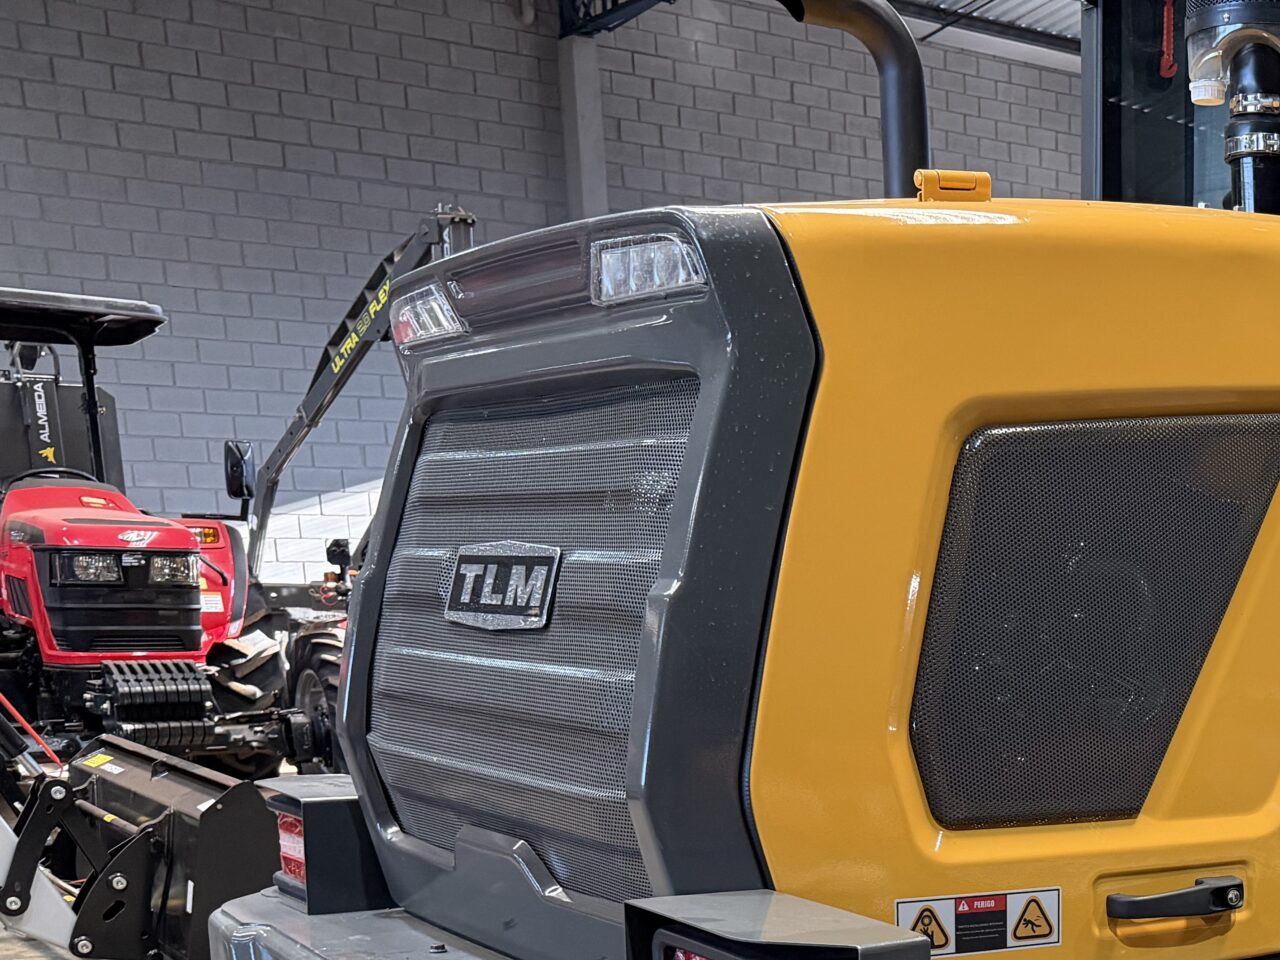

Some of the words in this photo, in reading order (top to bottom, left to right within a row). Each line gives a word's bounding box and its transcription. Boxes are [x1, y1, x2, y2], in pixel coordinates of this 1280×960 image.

[331, 332, 360, 374] ULTRA
[459, 563, 549, 607] TLM
[973, 899, 995, 909] PERIGO
